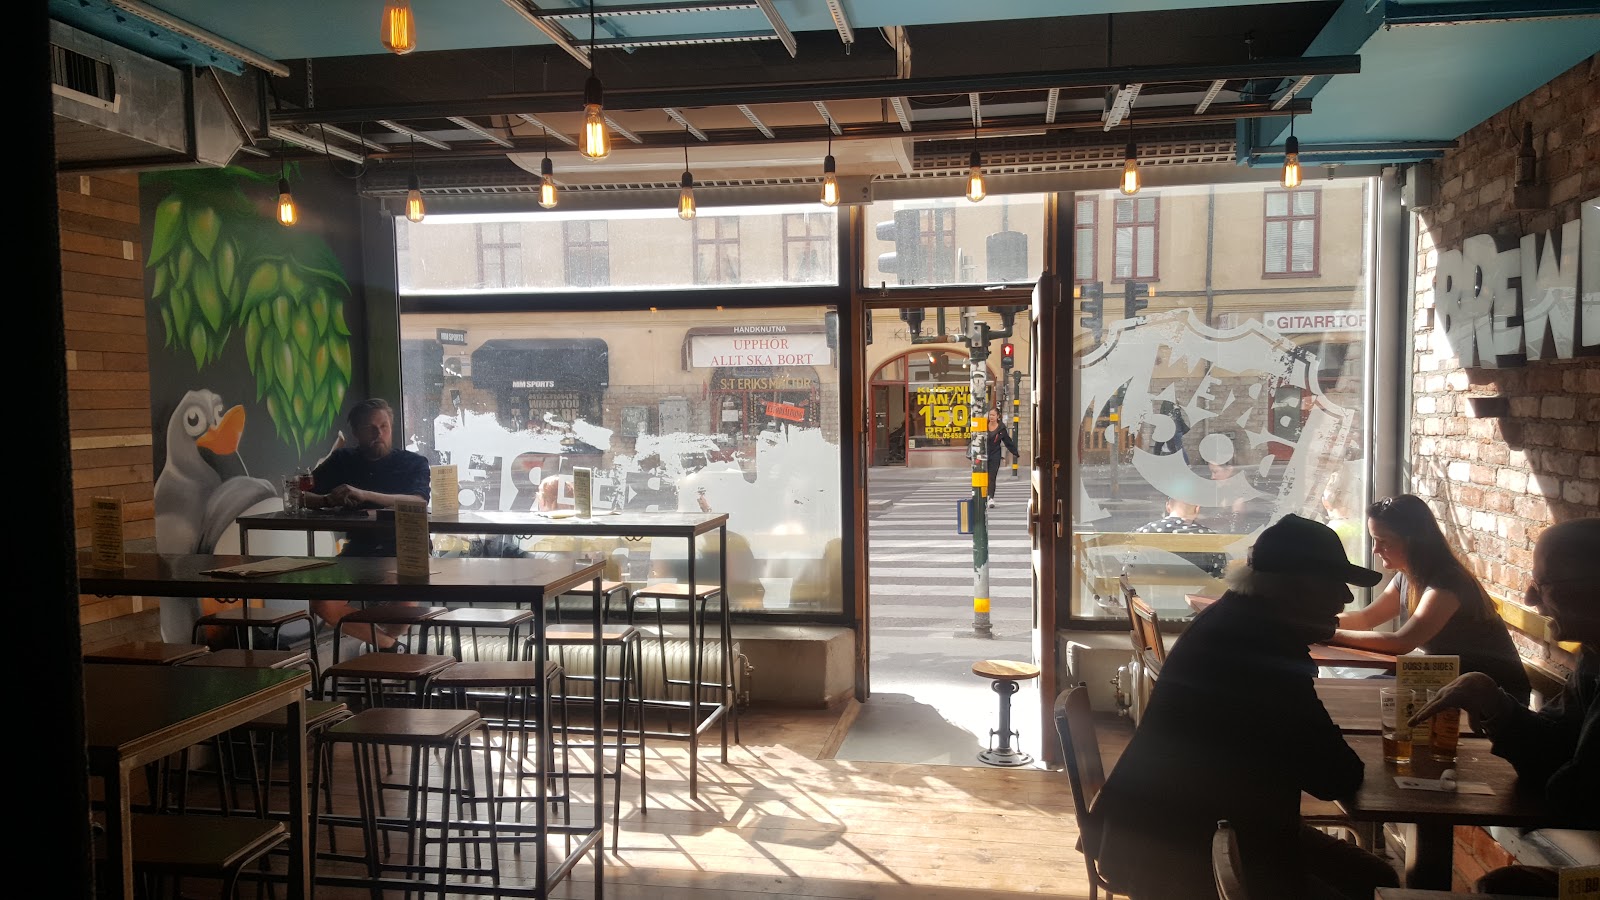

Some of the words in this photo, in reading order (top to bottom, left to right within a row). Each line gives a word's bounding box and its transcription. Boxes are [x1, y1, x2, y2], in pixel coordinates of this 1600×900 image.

[1435, 197, 1600, 369] BREW
[733, 325, 787, 333] HANDKNUTNA
[449, 333, 464, 342] SPORTS
[733, 336, 790, 351] UPPHÖR
[710, 355, 744, 366] ALLT
[746, 354, 773, 366] SKA
[778, 353, 814, 365] BORT
[526, 380, 555, 388] SPORTS
[738, 378, 767, 389] ERIKS
[559, 399, 580, 408] YOU
[1402, 662, 1422, 671] DOGS
[1423, 662, 1430, 671] &
[1432, 662, 1454, 671] SIDES
